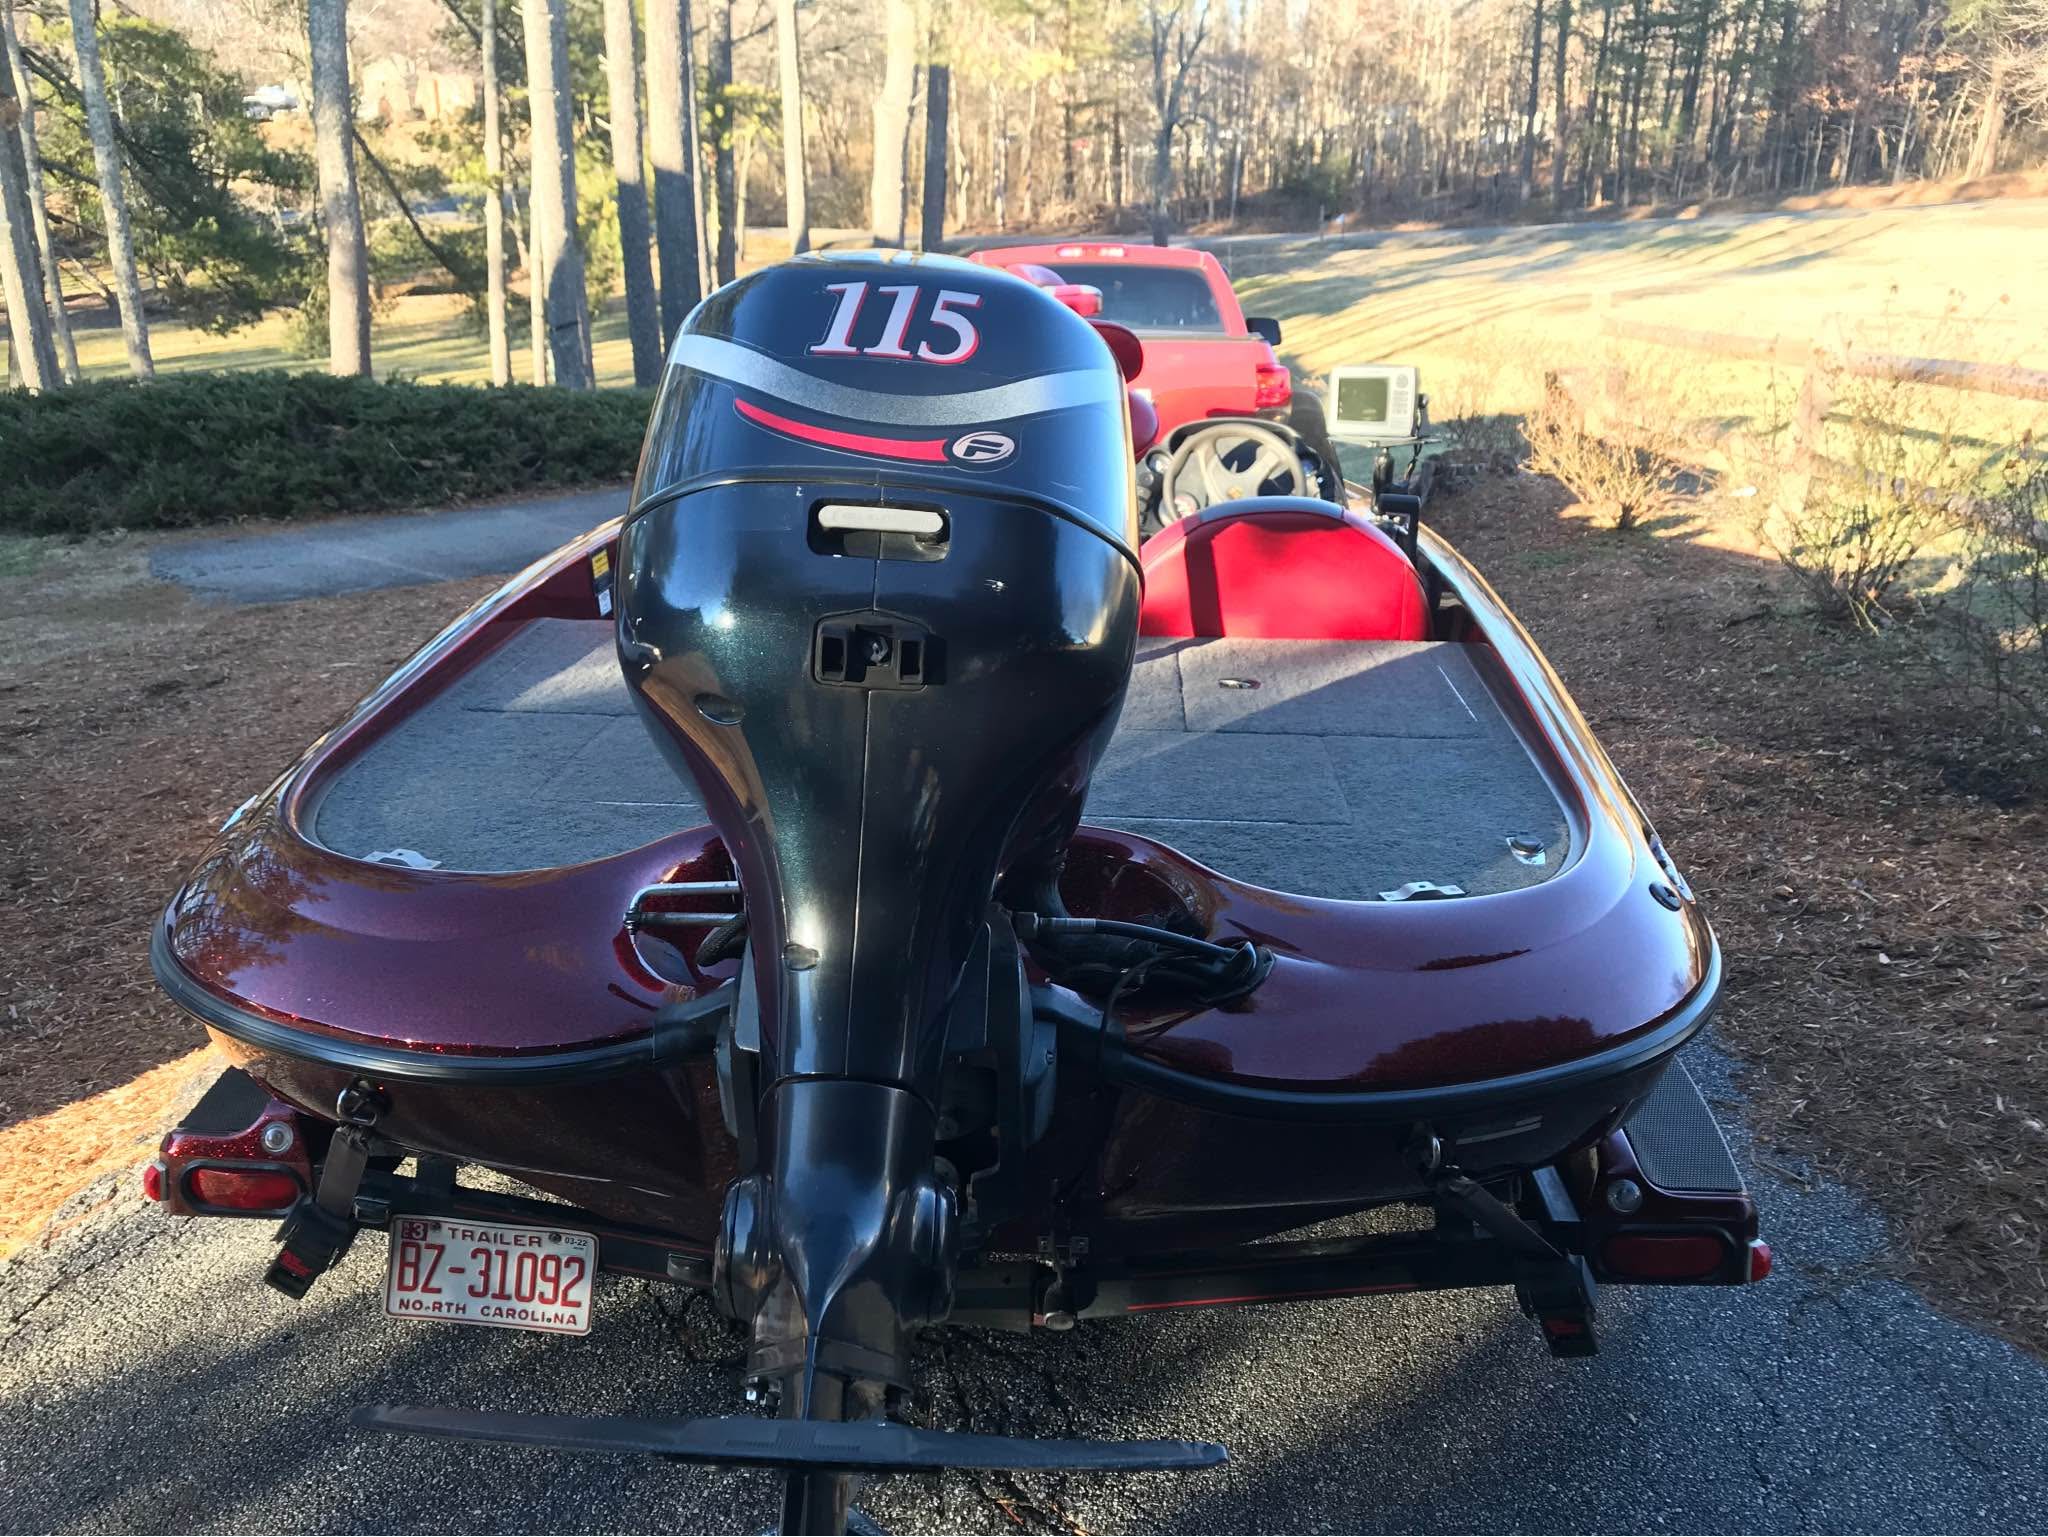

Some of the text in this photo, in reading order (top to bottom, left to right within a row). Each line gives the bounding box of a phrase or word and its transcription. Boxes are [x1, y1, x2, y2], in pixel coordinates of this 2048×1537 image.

[809, 280, 983, 365] 115
[411, 1222, 425, 1239] 3
[447, 1227, 543, 1247] TRAILER
[564, 1236, 588, 1247] 03-22
[397, 1241, 586, 1308] BZ-31092
[398, 1298, 578, 1326] NORTH CAROLINA
